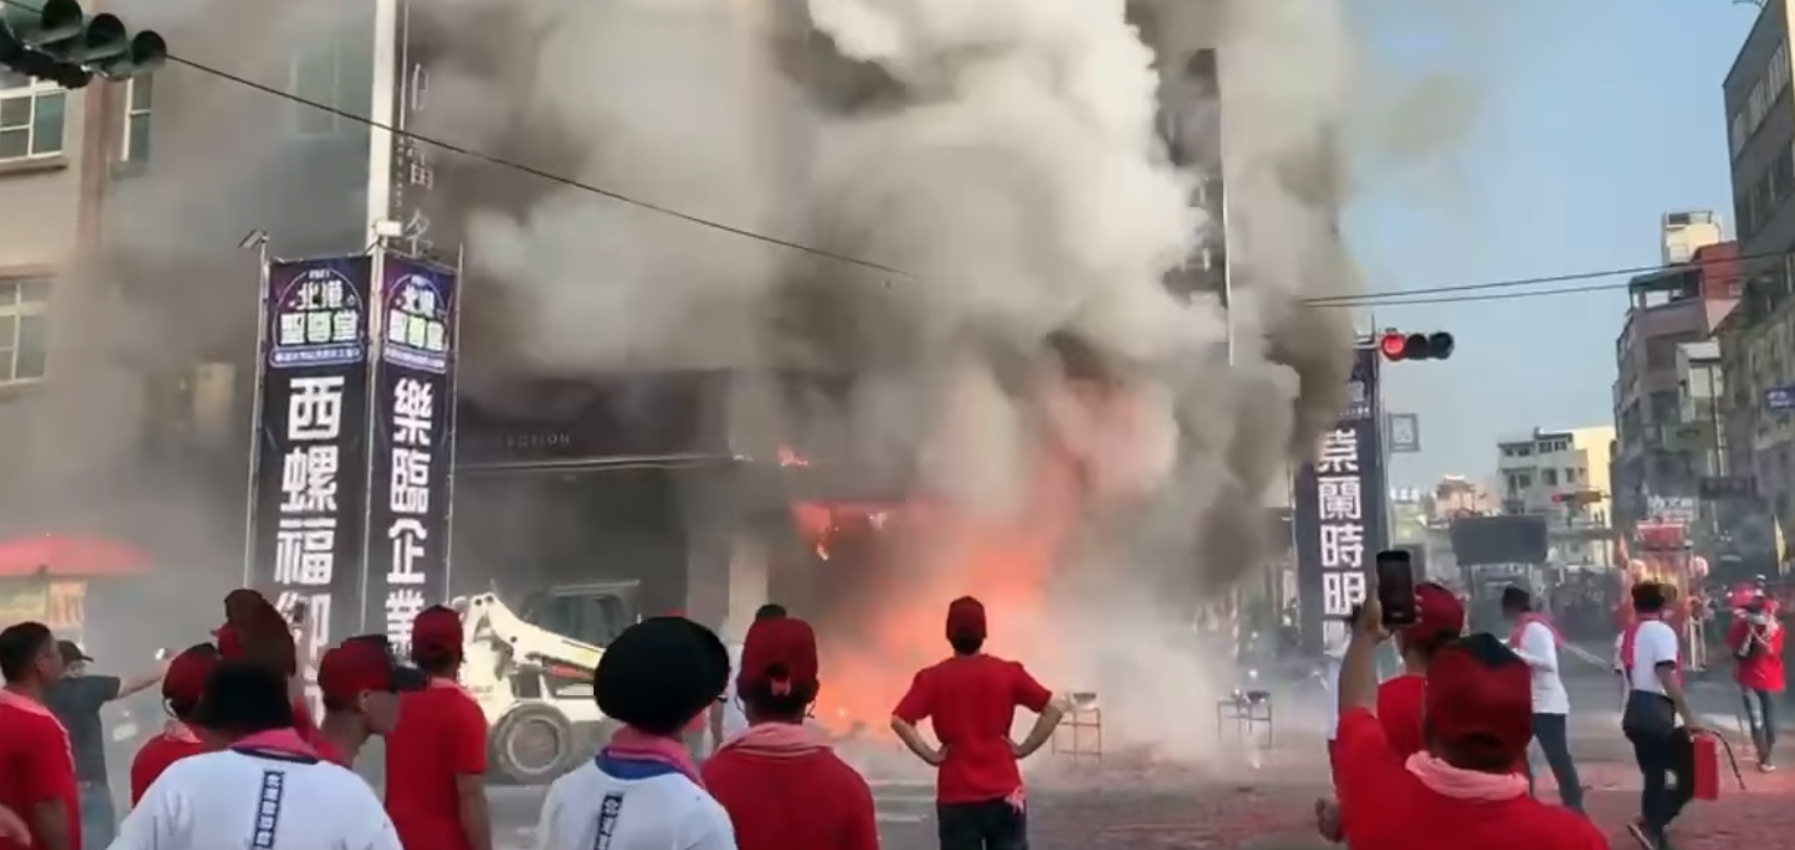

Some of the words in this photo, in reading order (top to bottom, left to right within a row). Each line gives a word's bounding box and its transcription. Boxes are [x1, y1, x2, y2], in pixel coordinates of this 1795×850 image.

[275, 376, 345, 727] 西螺福御
[386, 378, 432, 656] 樂臨企業
[1316, 428, 1367, 655] 崇蘭時明
